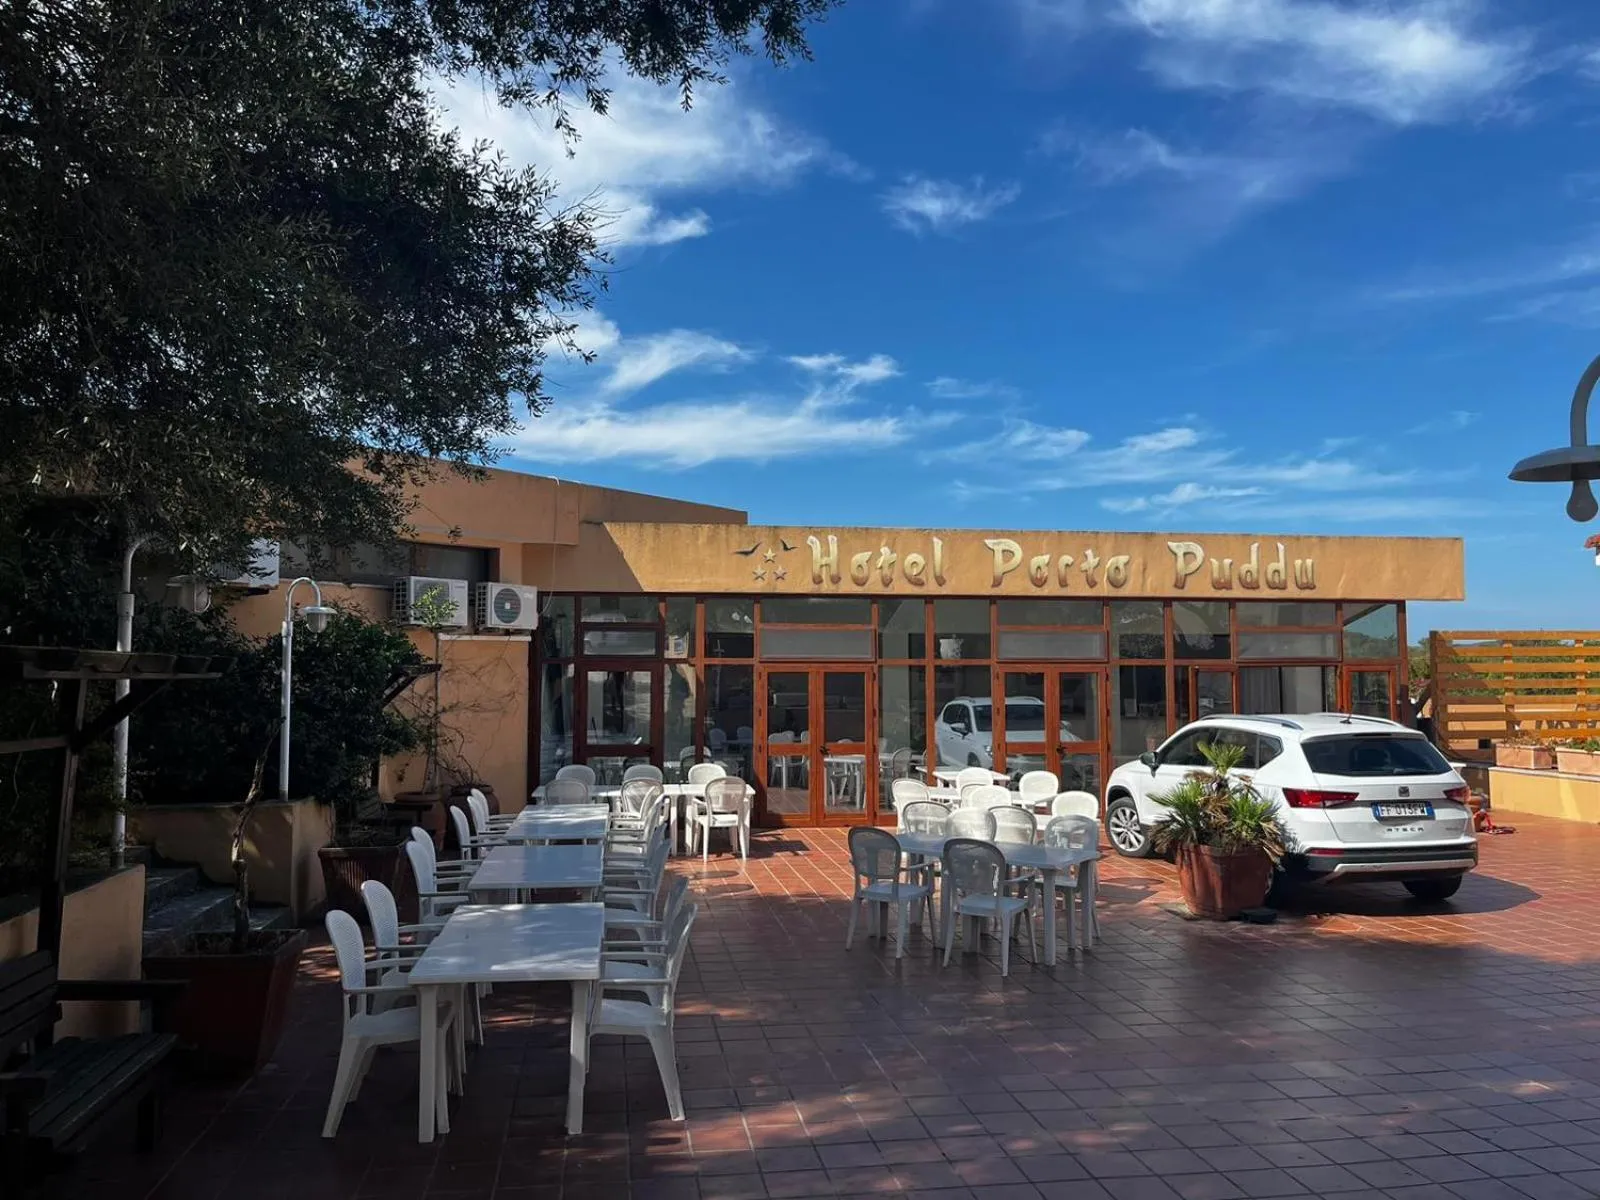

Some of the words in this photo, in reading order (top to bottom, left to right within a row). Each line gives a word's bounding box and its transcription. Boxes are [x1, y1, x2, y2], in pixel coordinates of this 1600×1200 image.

[807, 535, 946, 587] Hotel
[984, 538, 1130, 588] Porto
[1167, 541, 1316, 590] Puddu
